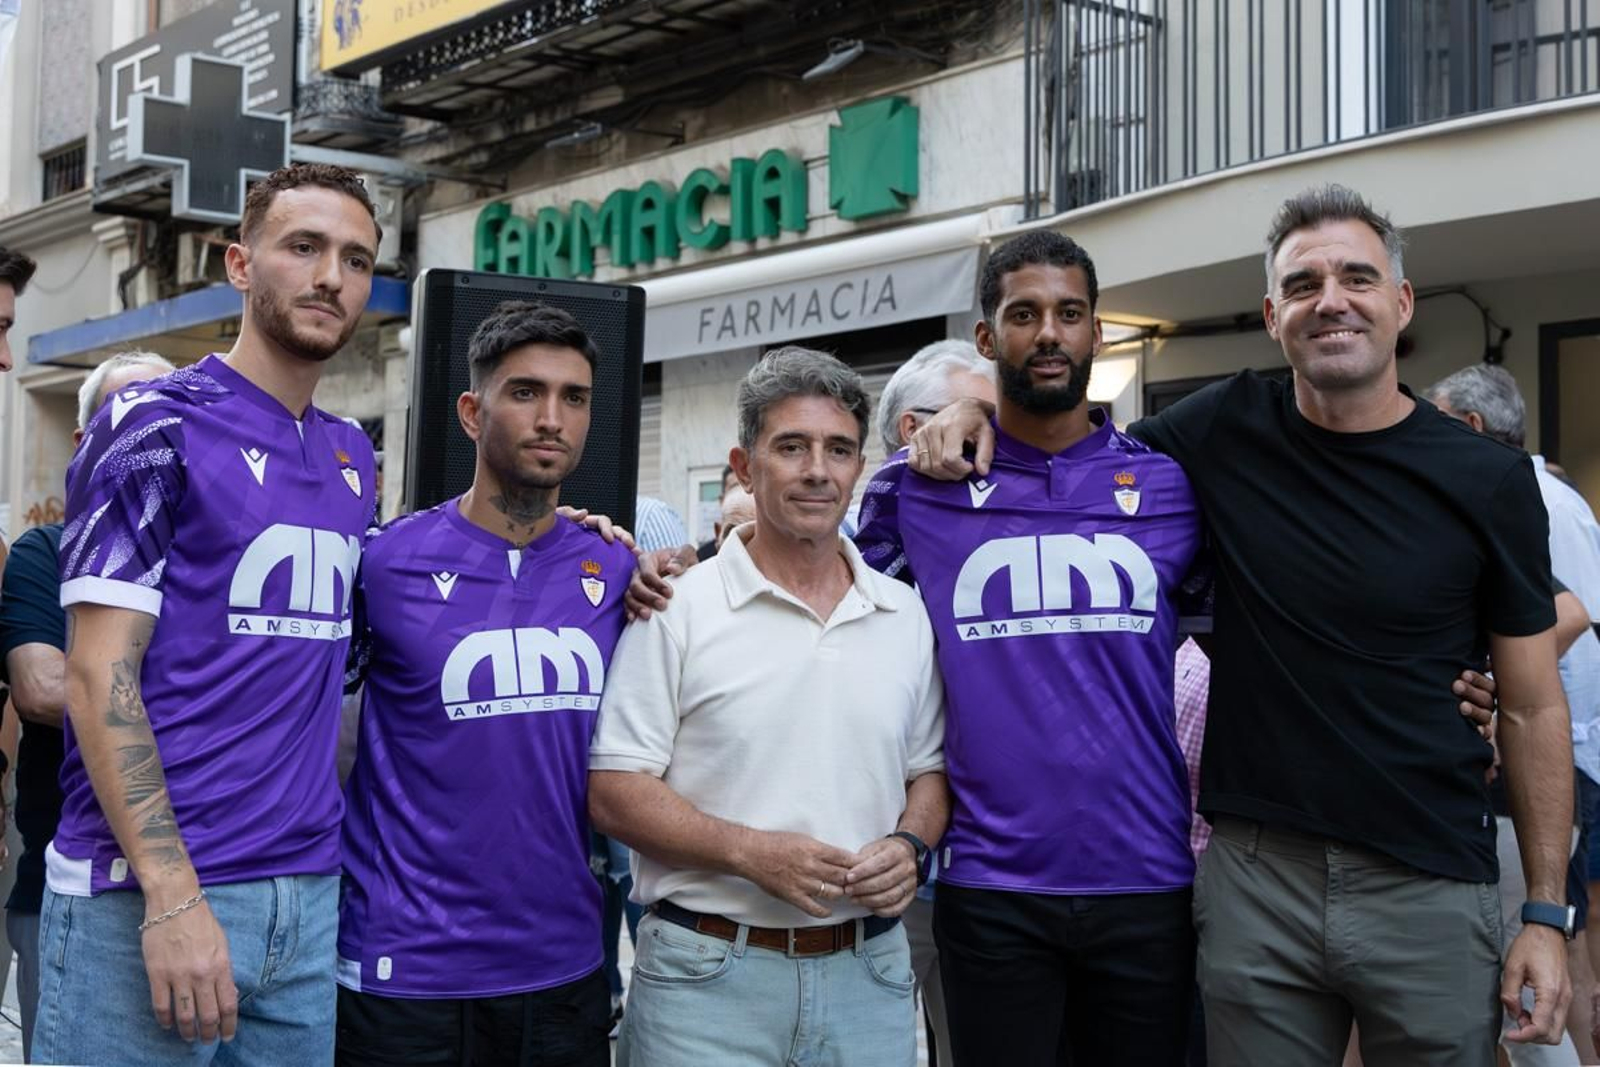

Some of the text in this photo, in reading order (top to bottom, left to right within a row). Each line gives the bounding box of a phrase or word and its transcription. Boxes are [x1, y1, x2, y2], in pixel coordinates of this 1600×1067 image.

[474, 148, 808, 278] FARMACIA
[697, 274, 897, 344] FARMACIA
[966, 616, 1145, 638] AMSYSTEM
